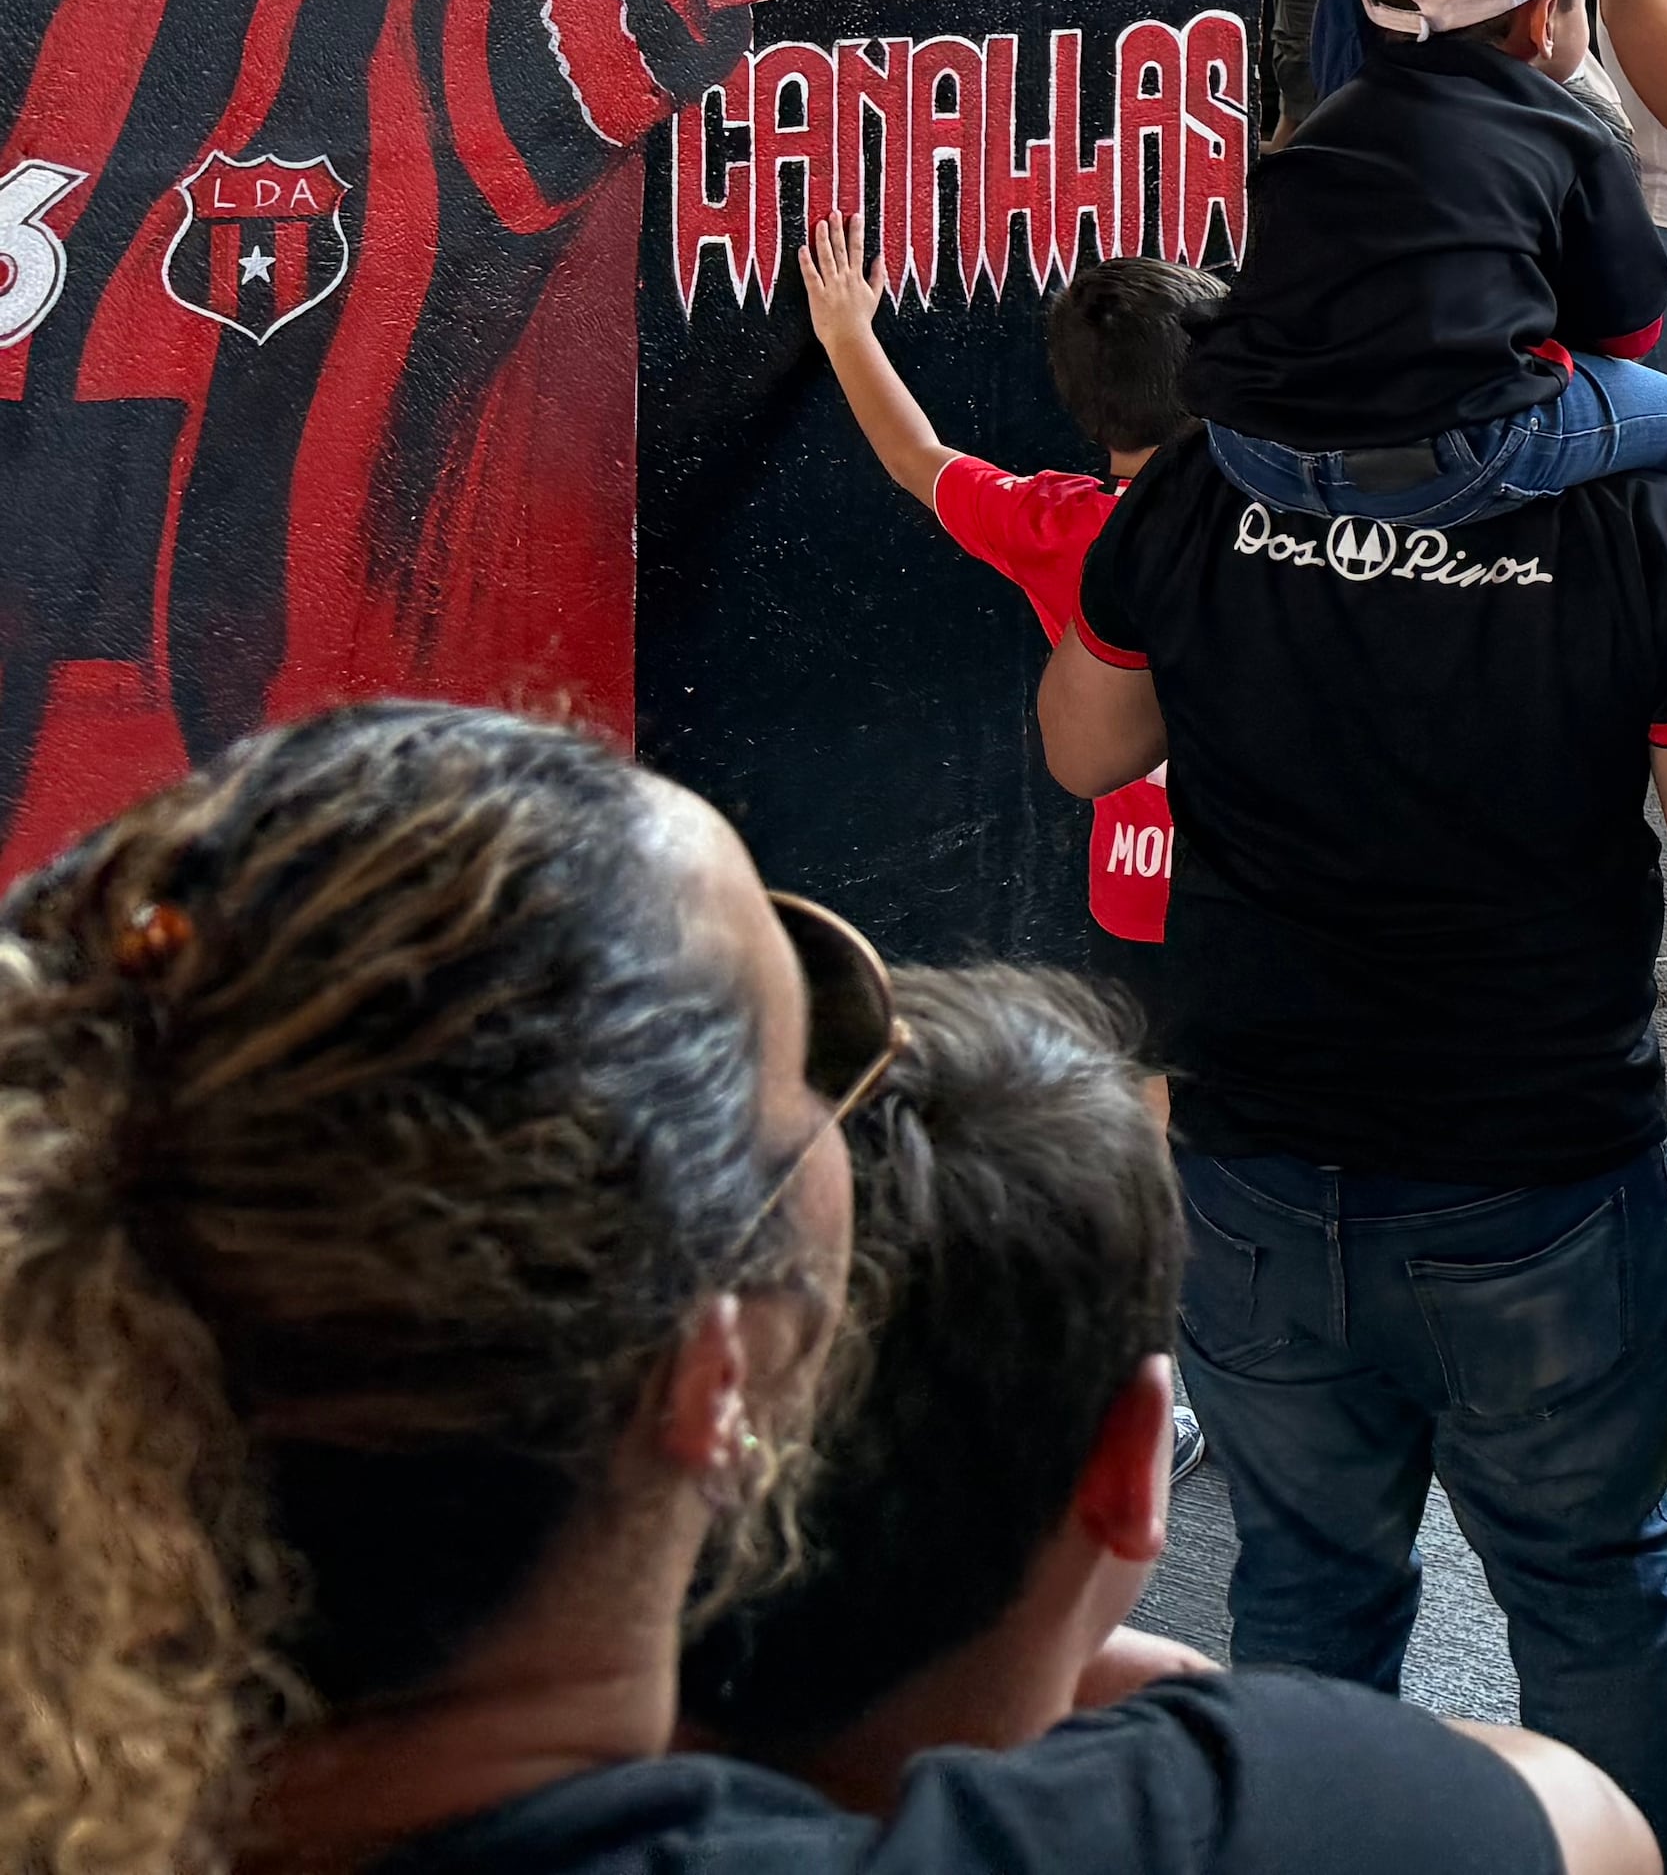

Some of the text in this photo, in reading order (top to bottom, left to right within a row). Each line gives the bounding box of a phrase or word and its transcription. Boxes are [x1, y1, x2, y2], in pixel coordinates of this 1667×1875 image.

[213, 178, 319, 210] LDA
[1233, 501, 1553, 588] Dos Pinos
